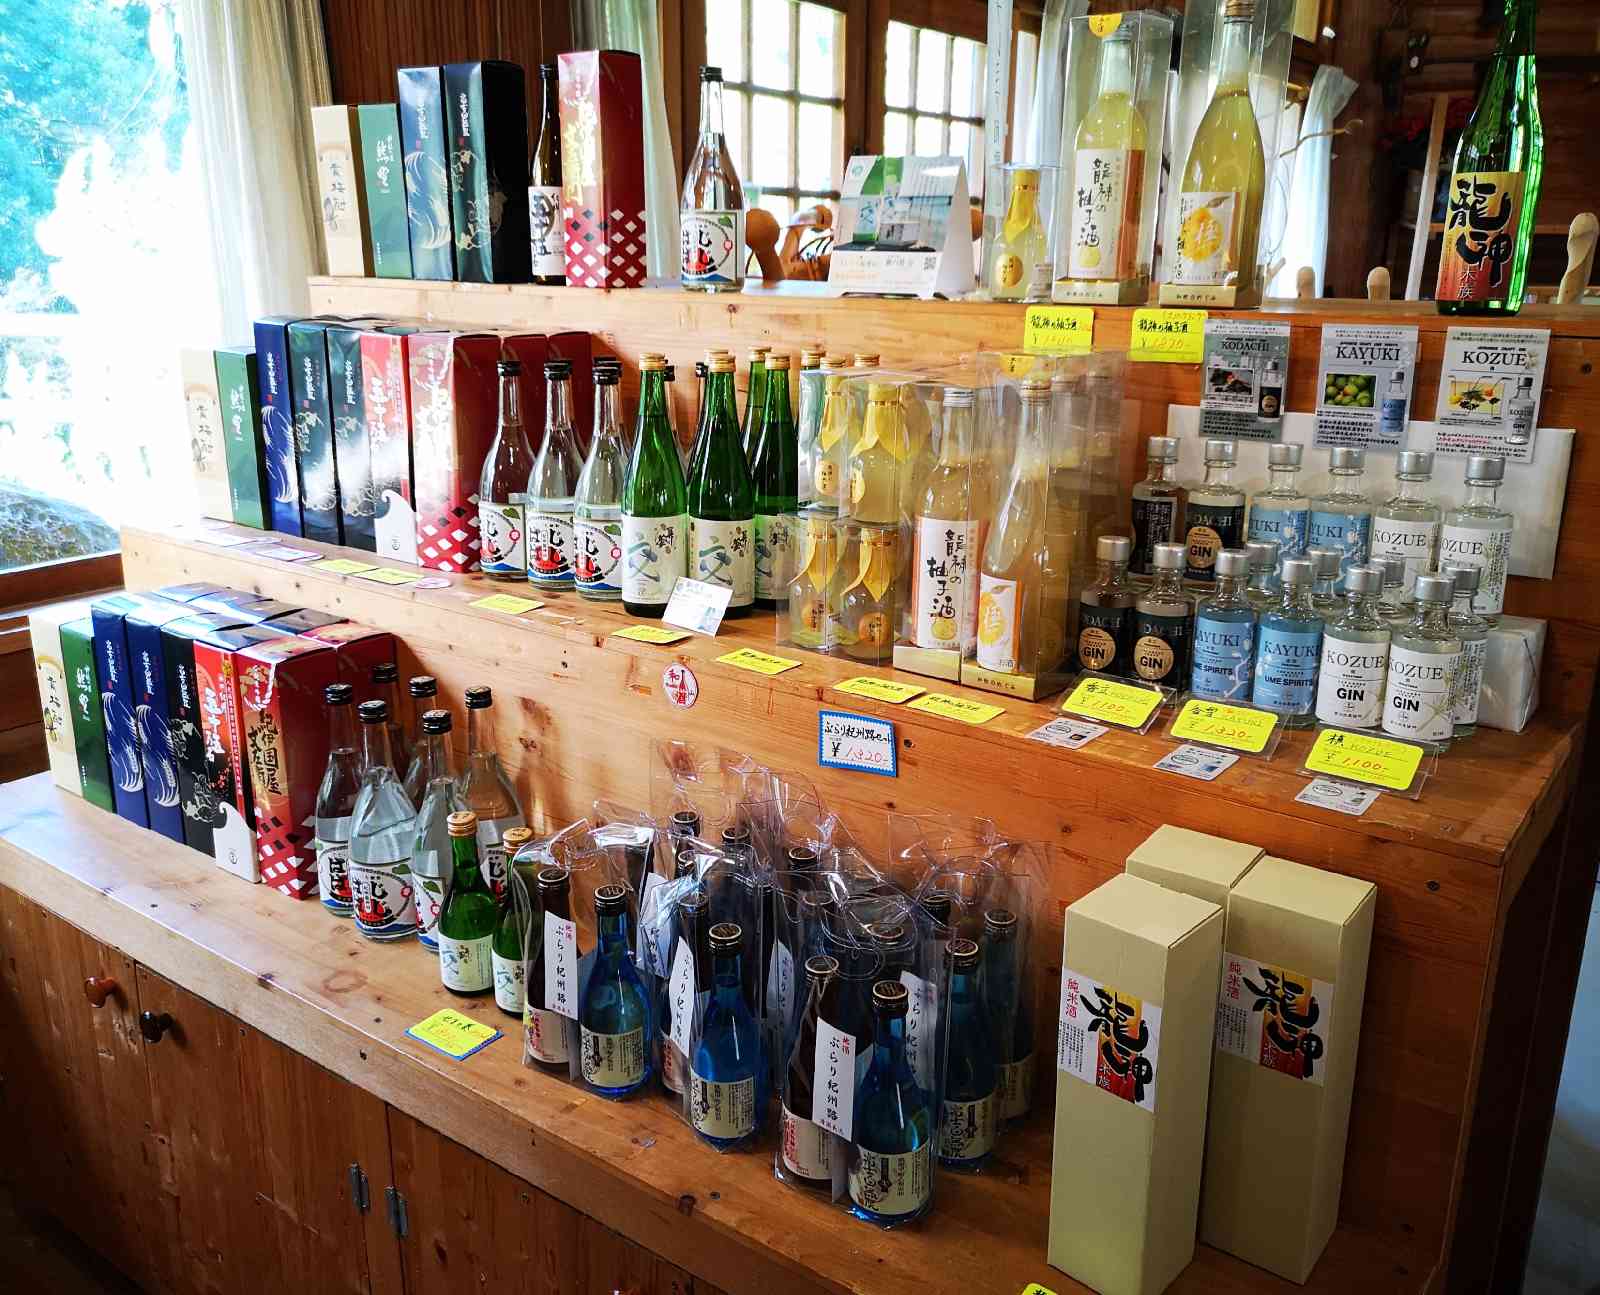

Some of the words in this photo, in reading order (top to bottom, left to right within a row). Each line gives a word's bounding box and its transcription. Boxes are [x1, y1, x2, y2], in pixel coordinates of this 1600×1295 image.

[1222, 341, 1270, 352] KODACHI
[1336, 345, 1400, 361] KAYUKI
[1462, 351, 1527, 367] KOZUE
[1191, 545, 1211, 557] GIN
[927, 556, 956, 619] 柚子酒
[1083, 646, 1105, 659] GIN
[1327, 650, 1384, 669] KOZUE
[1140, 656, 1163, 669] GIN
[1204, 664, 1233, 676] SPIRITS
[1265, 675, 1283, 686] UME
[1337, 688, 1364, 702] GIN
[1394, 697, 1419, 712] GIN
[832, 741, 841, 757] ¥
[554, 925, 568, 1004] ぶらり紀州路
[1066, 978, 1079, 1018] 純米酒
[826, 1036, 840, 1120] ぶらり紀州路
